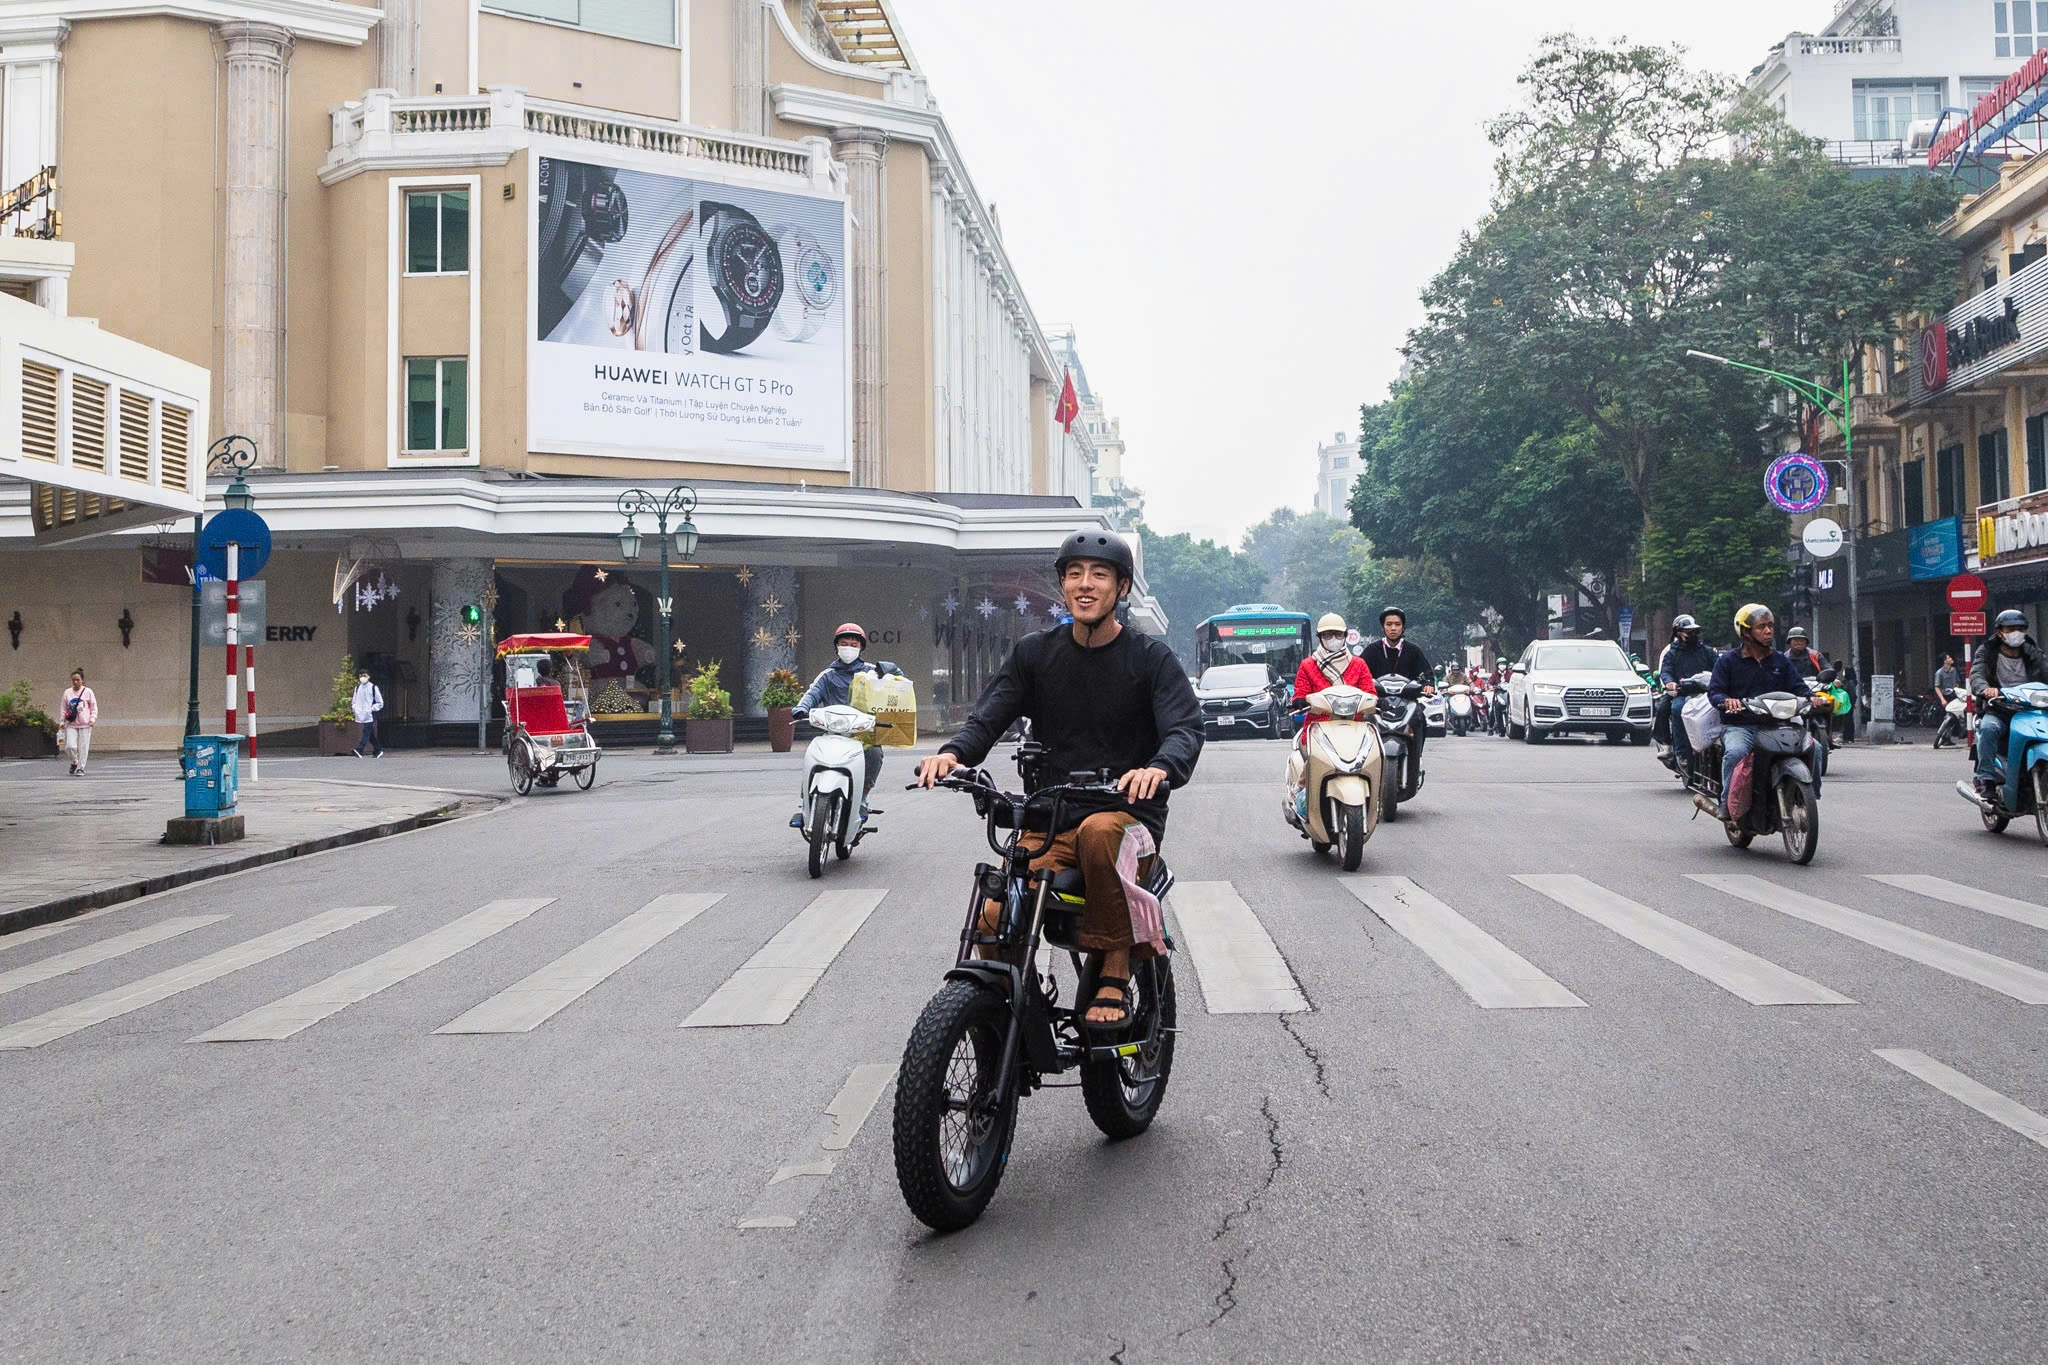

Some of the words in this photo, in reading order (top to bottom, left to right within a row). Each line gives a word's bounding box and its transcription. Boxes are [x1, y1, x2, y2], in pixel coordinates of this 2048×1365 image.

[681, 324, 692, 346] Oct
[595, 364, 667, 385] HUAWEI
[675, 371, 730, 390] WATCH
[734, 377, 754, 392] GT
[759, 379, 767, 394] 5
[771, 380, 793, 396] Pro
[601, 392, 635, 403] Ceramic
[650, 395, 682, 406] Titanium
[775, 417, 780, 426] 2
[1818, 569, 1833, 589] MLB
[266, 626, 317, 641] ERRY
[868, 631, 900, 644] CCI
